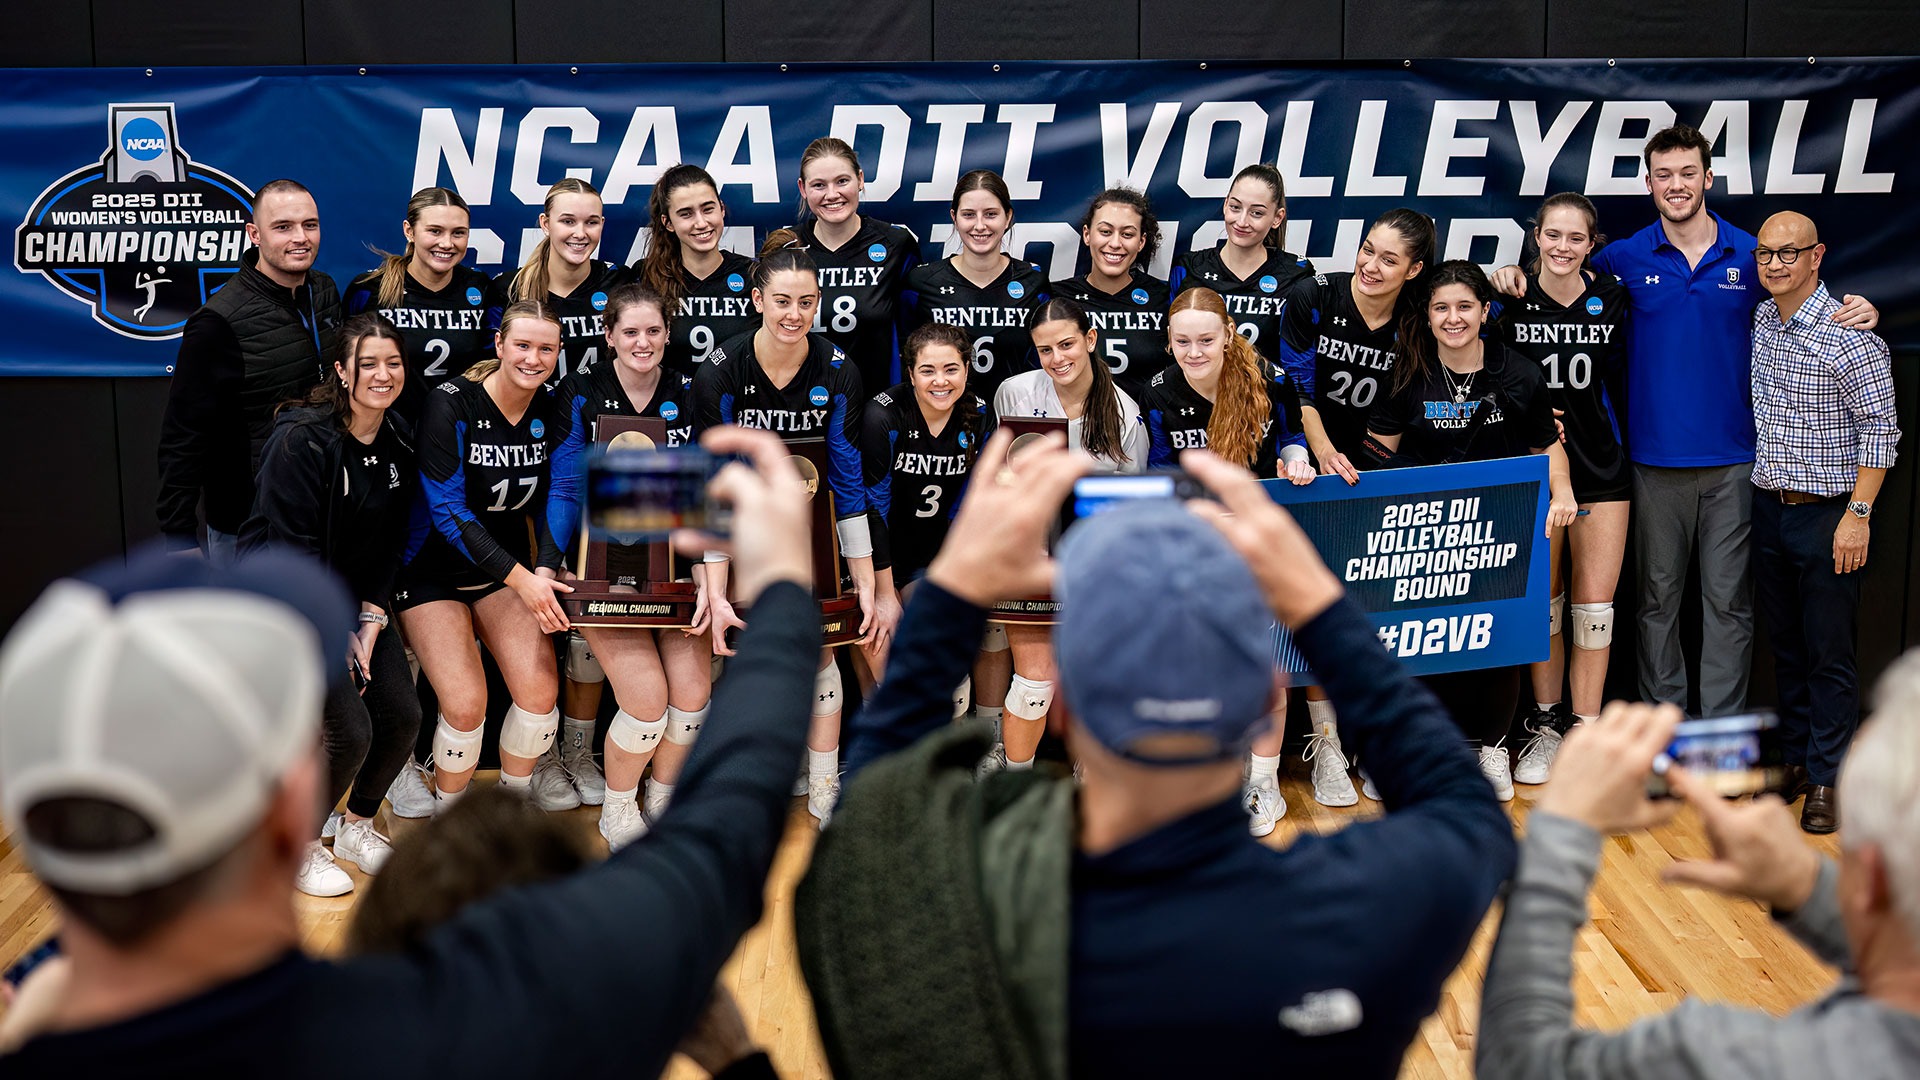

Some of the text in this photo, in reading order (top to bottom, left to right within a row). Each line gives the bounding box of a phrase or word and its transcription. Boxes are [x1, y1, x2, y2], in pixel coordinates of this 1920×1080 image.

[126, 138, 165, 151] NCAA
[411, 99, 1895, 206] NCAA DII VOLLEYBALL
[92, 193, 203, 208] 2025 DII
[51, 209, 245, 226] WOMEN'S VOLLEYBALL
[379, 308, 485, 330] BENTLEY
[673, 296, 750, 317] NTLEY
[931, 306, 1030, 328] BENTLEY
[1085, 311, 1163, 331] NTLEY
[689, 325, 715, 363] 9
[1514, 322, 1615, 344] BENTLEY
[424, 338, 451, 376] 2
[971, 335, 995, 373] 6
[1105, 338, 1129, 375] 5
[1317, 334, 1397, 371] BENTLE
[1541, 352, 1592, 390] 10
[1326, 370, 1378, 408] 20
[468, 441, 548, 468] BENTLE
[894, 452, 967, 476] BENTLE
[487, 476, 538, 511] 17
[915, 484, 943, 518] 3
[1381, 496, 1481, 529] 2025 DII
[1367, 520, 1496, 555] VOLLEYBALL
[1345, 542, 1517, 582] CHAMPIONSHIP
[617, 575, 636, 585] 2025
[1393, 572, 1471, 602] BOUND
[587, 602, 671, 615] REGIONAL CHAMPION
[992, 600, 1025, 610] EGIONAL
[821, 621, 842, 633] PION
[1376, 612, 1494, 658] #D2VB
